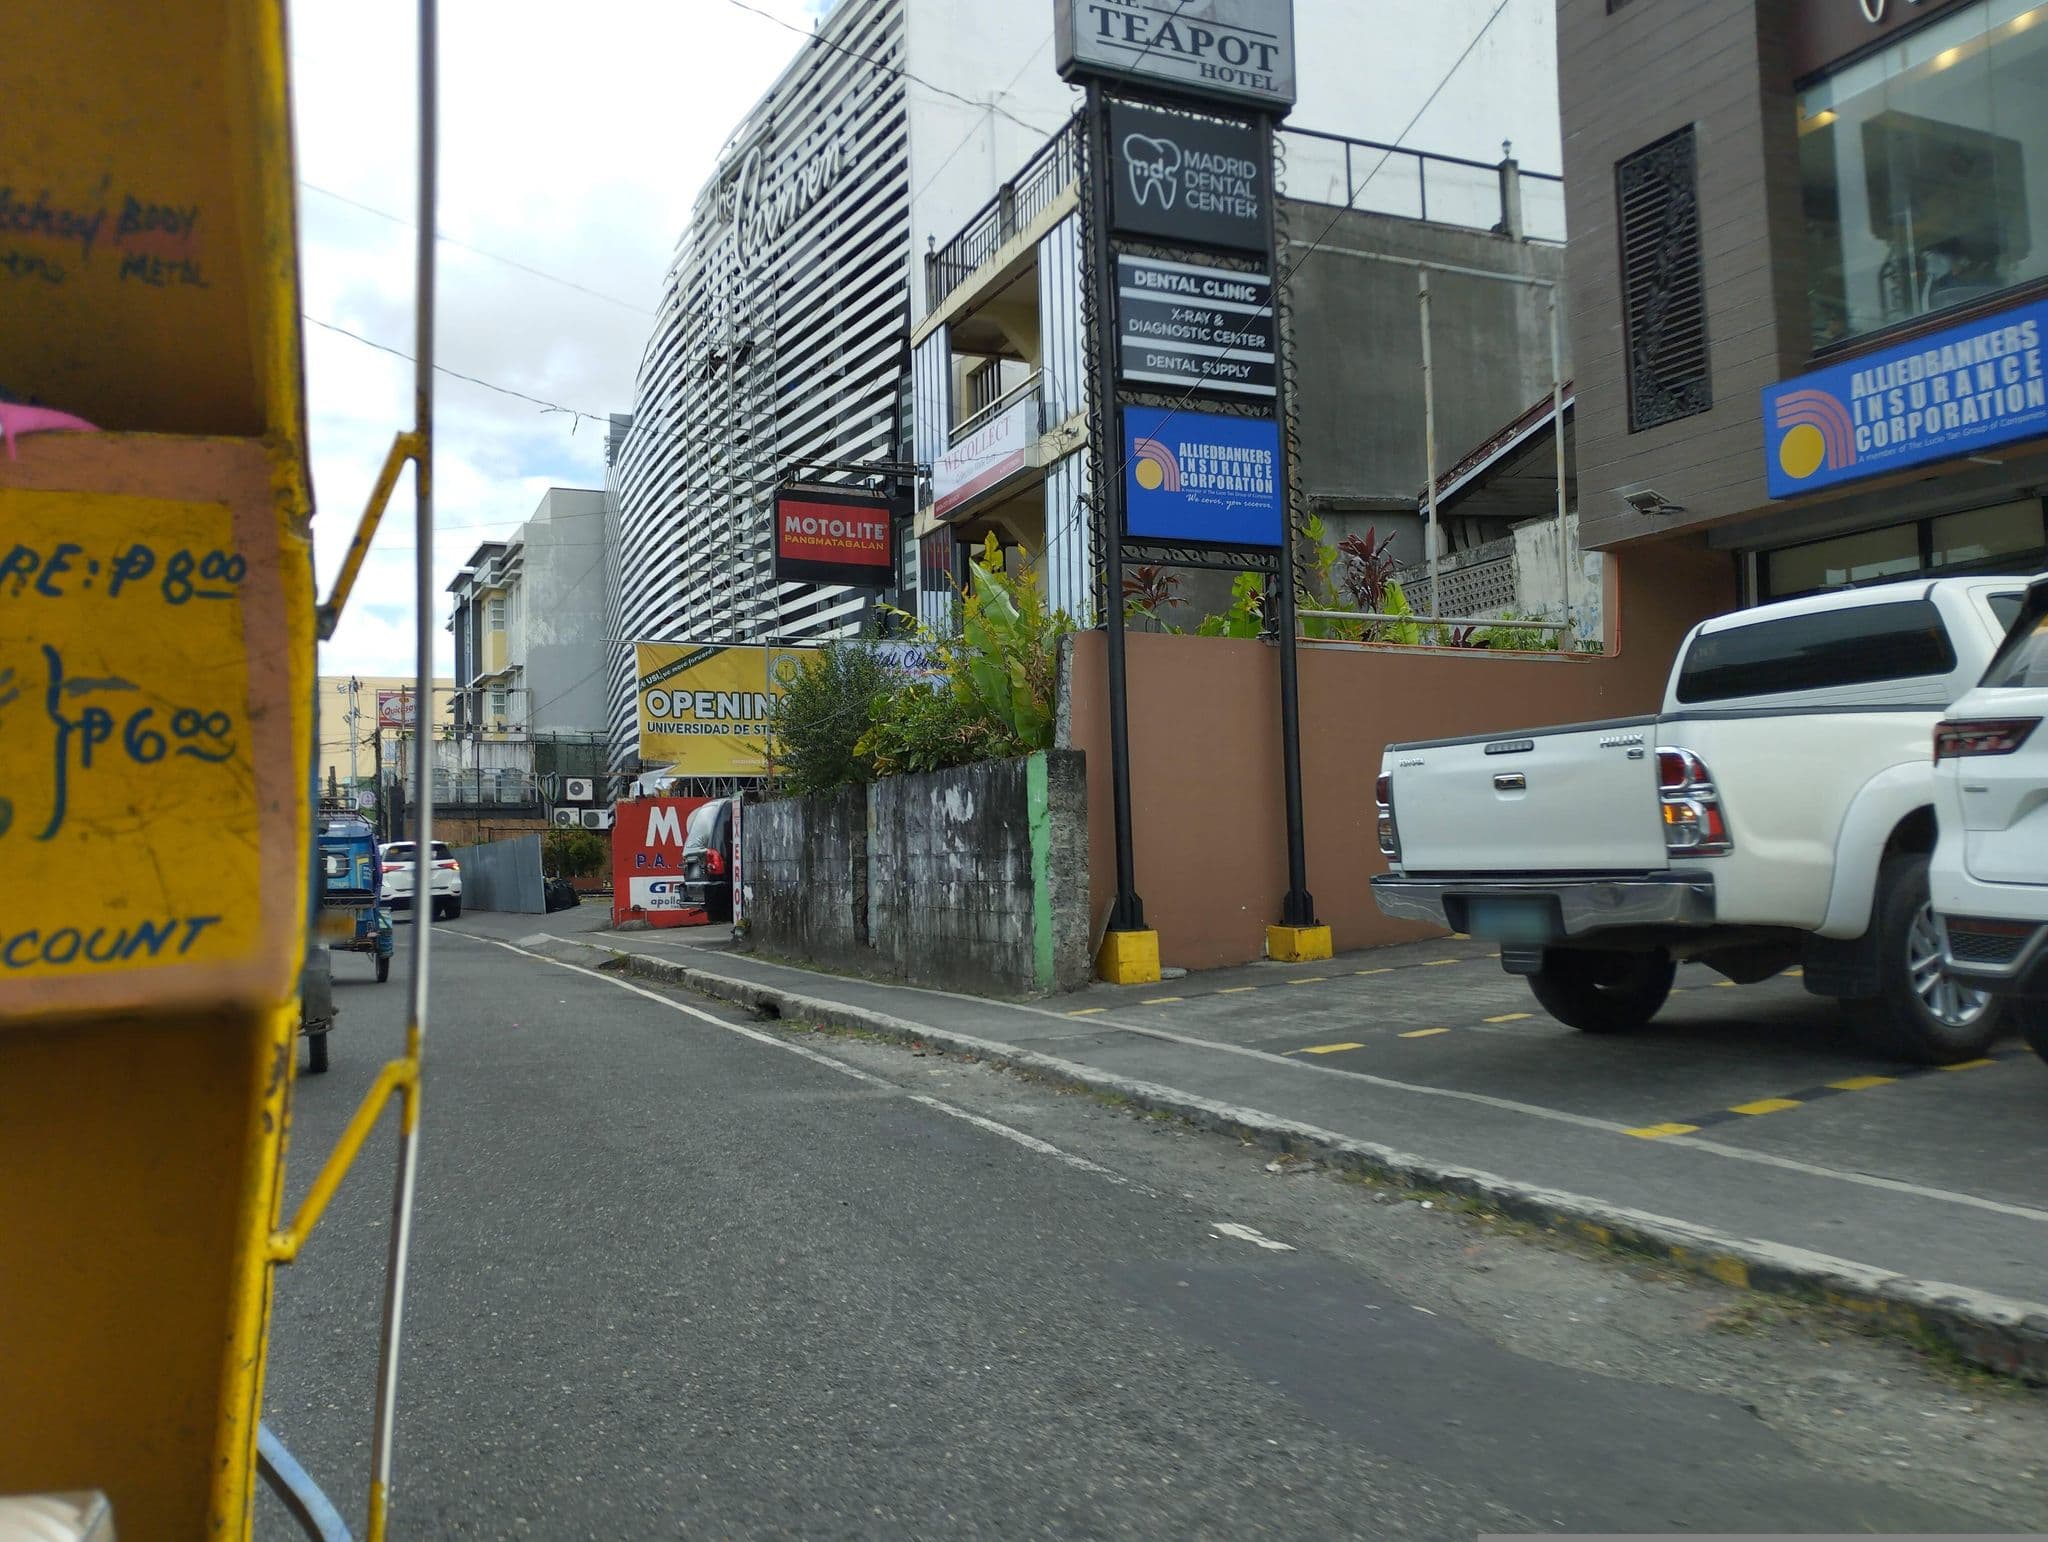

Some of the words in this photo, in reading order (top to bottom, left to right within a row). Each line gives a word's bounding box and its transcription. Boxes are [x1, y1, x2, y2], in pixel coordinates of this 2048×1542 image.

[1089, 5, 1279, 72] TEAPOT
[1200, 62, 1278, 92] HOTEL
[1184, 150, 1257, 179] MADRID
[1185, 170, 1256, 199] DENTAL
[1185, 190, 1258, 219] CENTER
[1134, 270, 1200, 294] DENTAL
[1203, 280, 1257, 302] CLINIC
[1171, 308, 1212, 326] X-RAY
[1213, 314, 1225, 328] &
[1129, 319, 1211, 341] DIAGNOSTIC
[1213, 330, 1266, 348] CENTER
[1146, 354, 1200, 373] DENTAL
[1201, 361, 1251, 378] SUPPLY
[1852, 319, 2040, 399] ALLIEDBANKERS
[1853, 348, 2043, 425] INSURANCE
[1855, 378, 2046, 453] CORPORATION
[1179, 442, 1272, 465] ALLIEDBANKERS
[1180, 458, 1272, 479] INSURANCE
[1180, 472, 1273, 493] CORPORATION
[784, 534, 884, 550] PANGMATAGALAN
[785, 516, 885, 540] MOTOLITE
[647, 721, 730, 736] UNIVERSIDAD
[733, 723, 751, 736] DE
[1600, 734, 1644, 748] HILUX
